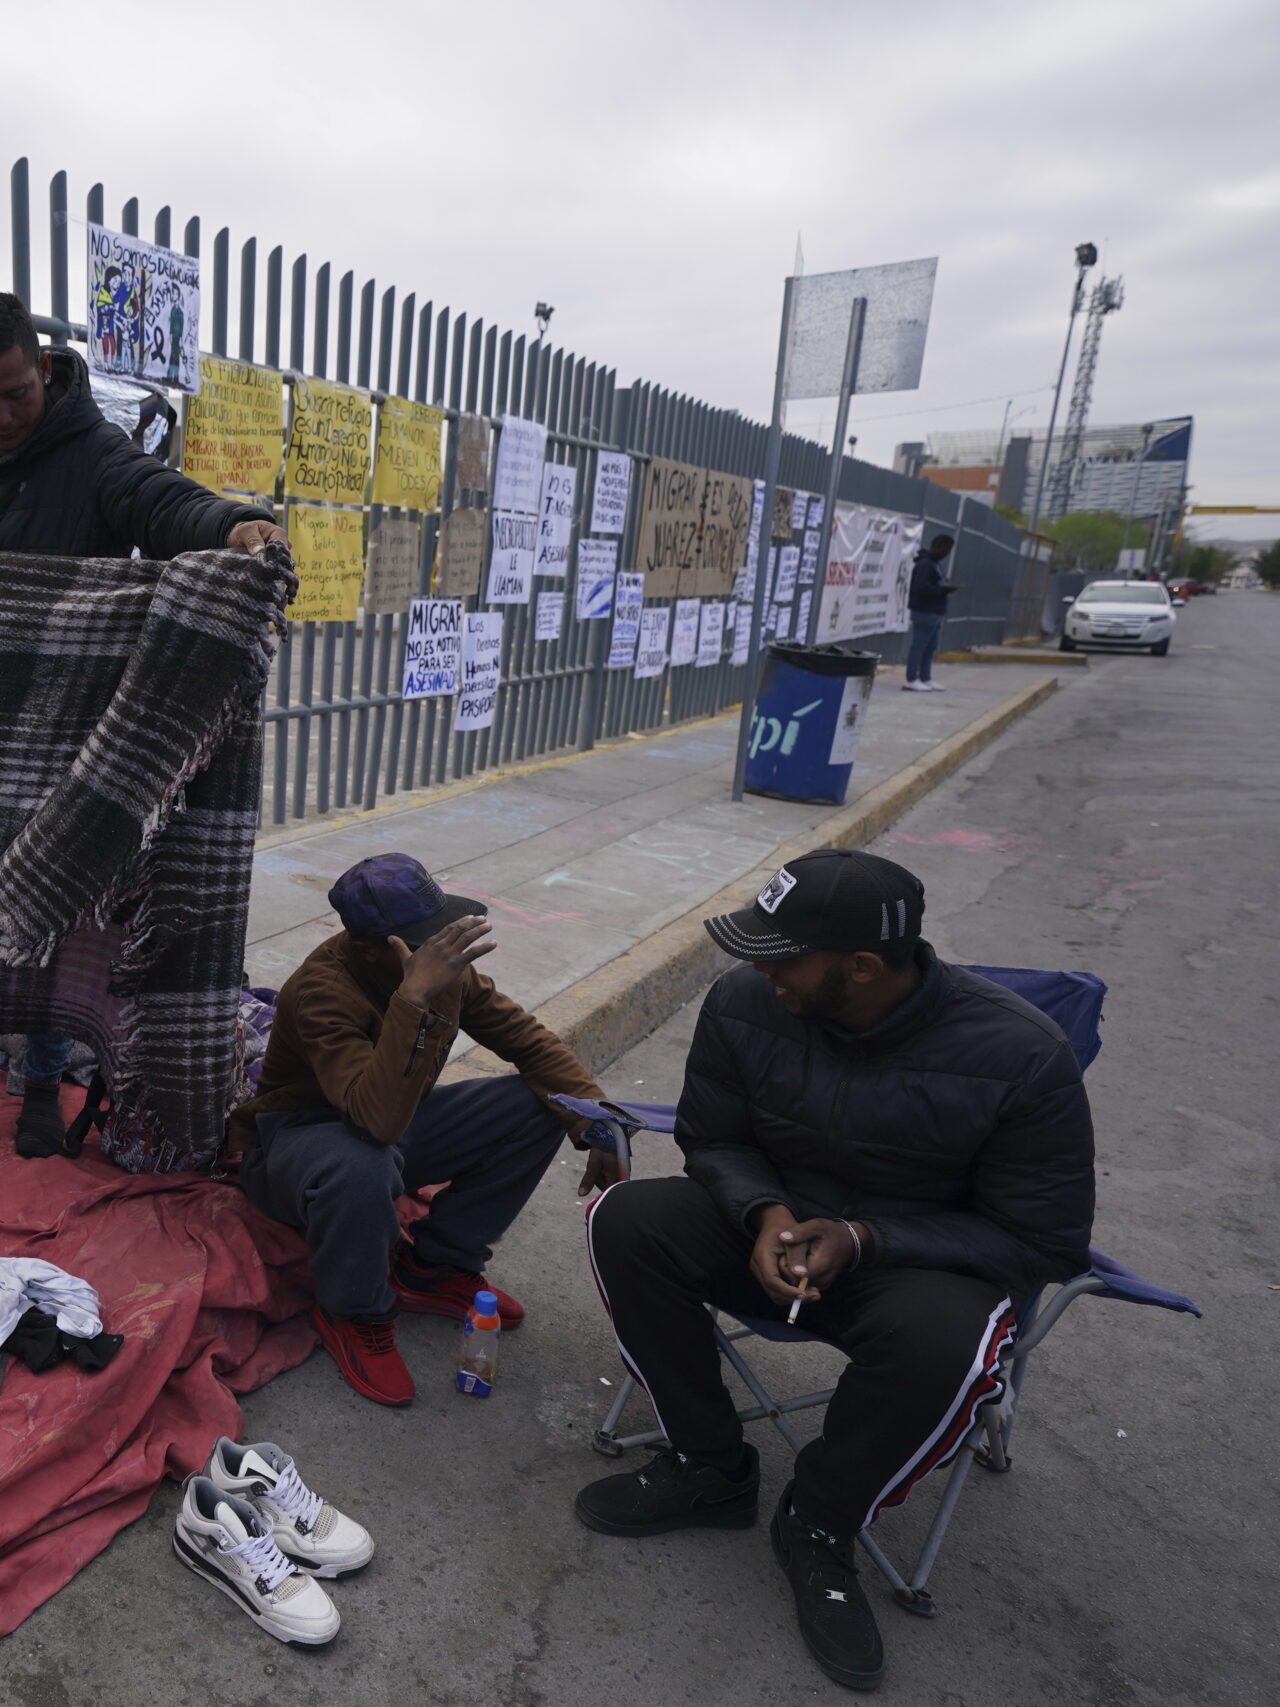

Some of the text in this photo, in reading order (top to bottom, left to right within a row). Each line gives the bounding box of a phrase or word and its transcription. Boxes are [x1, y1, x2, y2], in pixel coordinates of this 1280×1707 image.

[91, 229, 110, 259] NO
[216, 471, 250, 485] HUMANO
[393, 467, 426, 491] TODES
[297, 572, 333, 593] roteger
[468, 618, 484, 633] Los
[407, 641, 420, 658] NO
[424, 640, 434, 656] ES
[419, 656, 440, 673] PARA
[405, 671, 457, 696] ASESINAD
